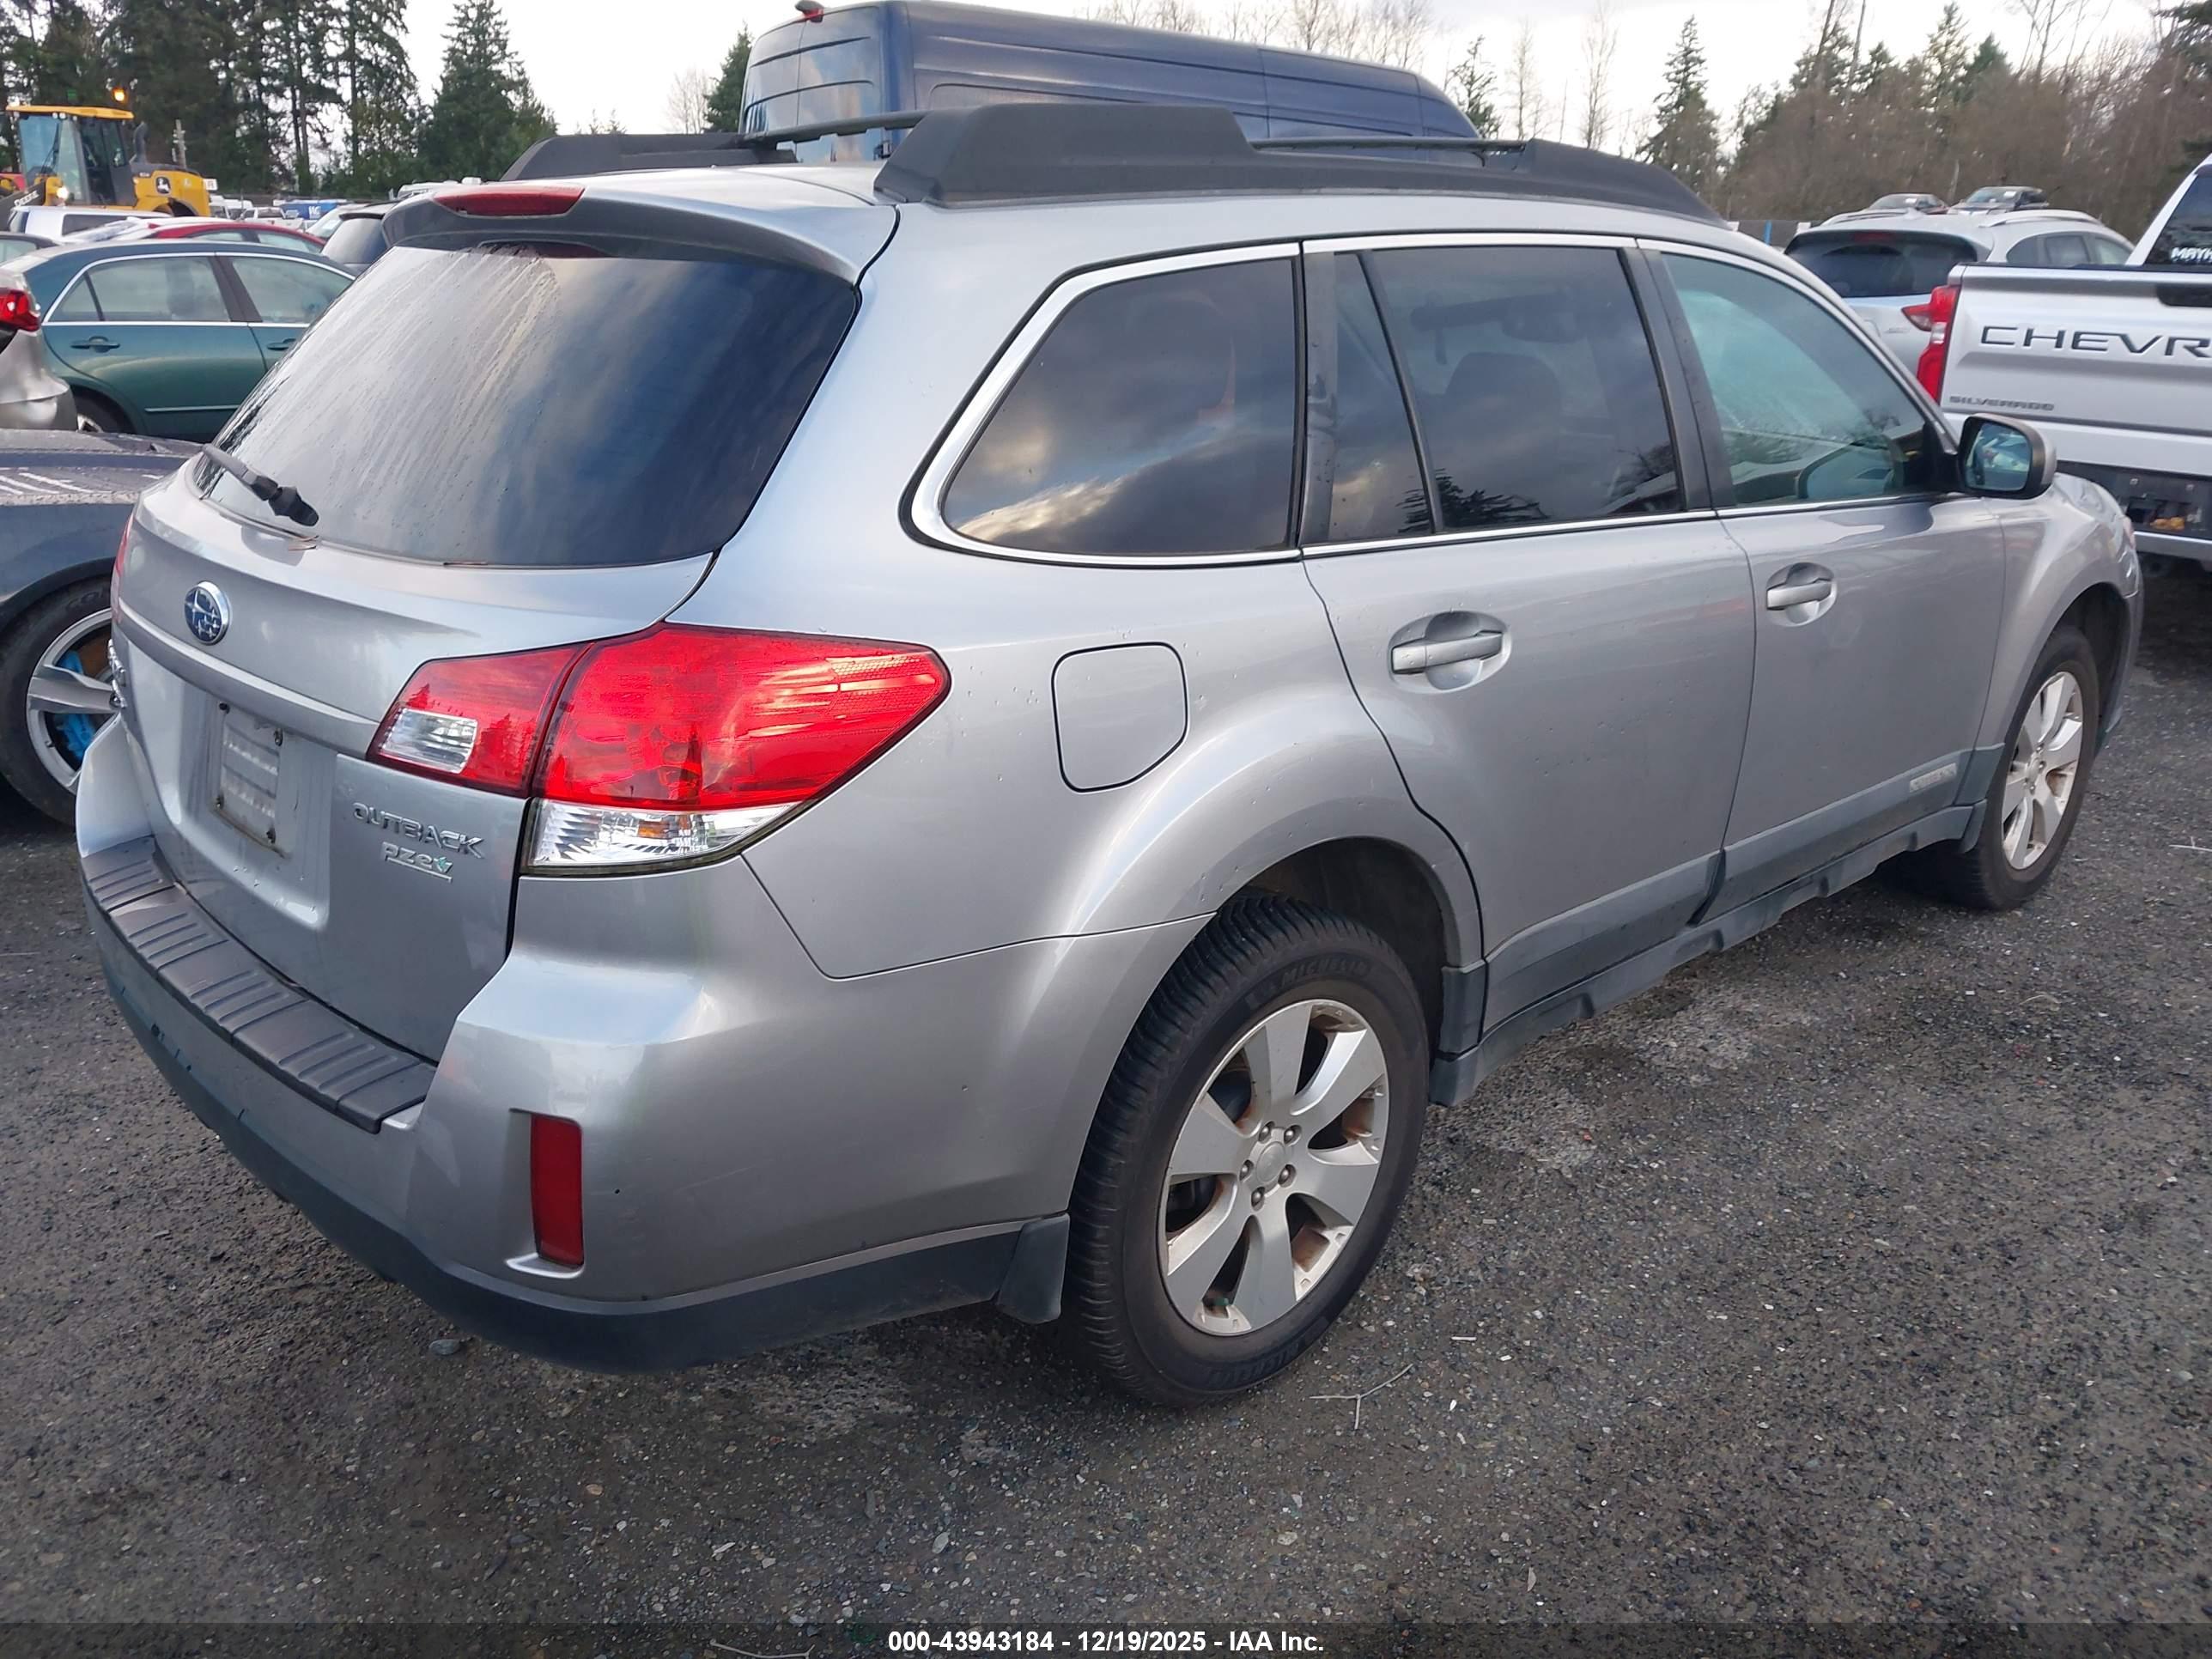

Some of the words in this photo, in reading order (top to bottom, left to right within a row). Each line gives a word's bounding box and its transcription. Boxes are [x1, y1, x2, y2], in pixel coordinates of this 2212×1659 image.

[1980, 325, 2212, 358] CHEVR
[1948, 395, 2055, 411] SILVERADO
[352, 801, 485, 860] OUTBACK
